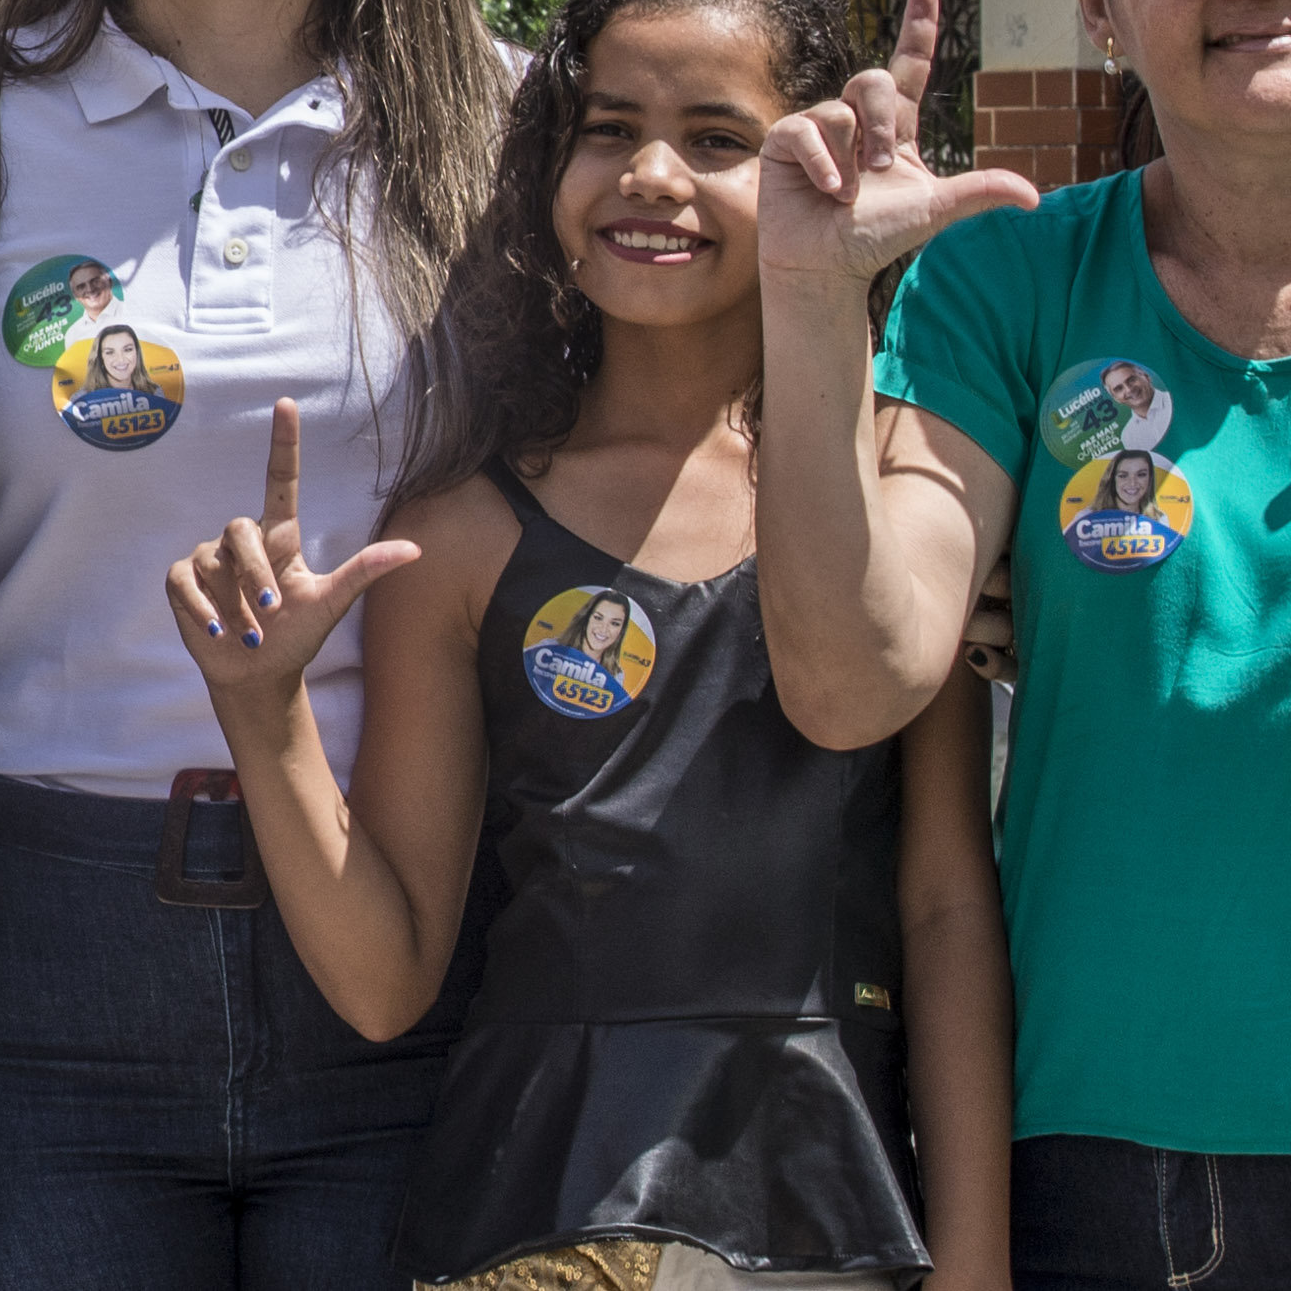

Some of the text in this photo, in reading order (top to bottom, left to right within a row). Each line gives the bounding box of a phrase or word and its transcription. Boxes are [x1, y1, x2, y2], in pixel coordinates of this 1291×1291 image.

[22, 281, 65, 307] Lucélio
[36, 295, 73, 323] 43
[28, 329, 47, 342] FAZ
[45, 318, 69, 334] MAIS
[72, 392, 150, 422] Camila
[1058, 387, 1101, 419] Lucélio
[1082, 399, 1119, 432] 43
[106, 412, 163, 435] 45123
[1096, 421, 1120, 439] MAIS
[1076, 515, 1153, 541] Camila
[1104, 538, 1162, 557] 45123
[534, 647, 608, 690] Camila
[555, 679, 611, 710] 45123
